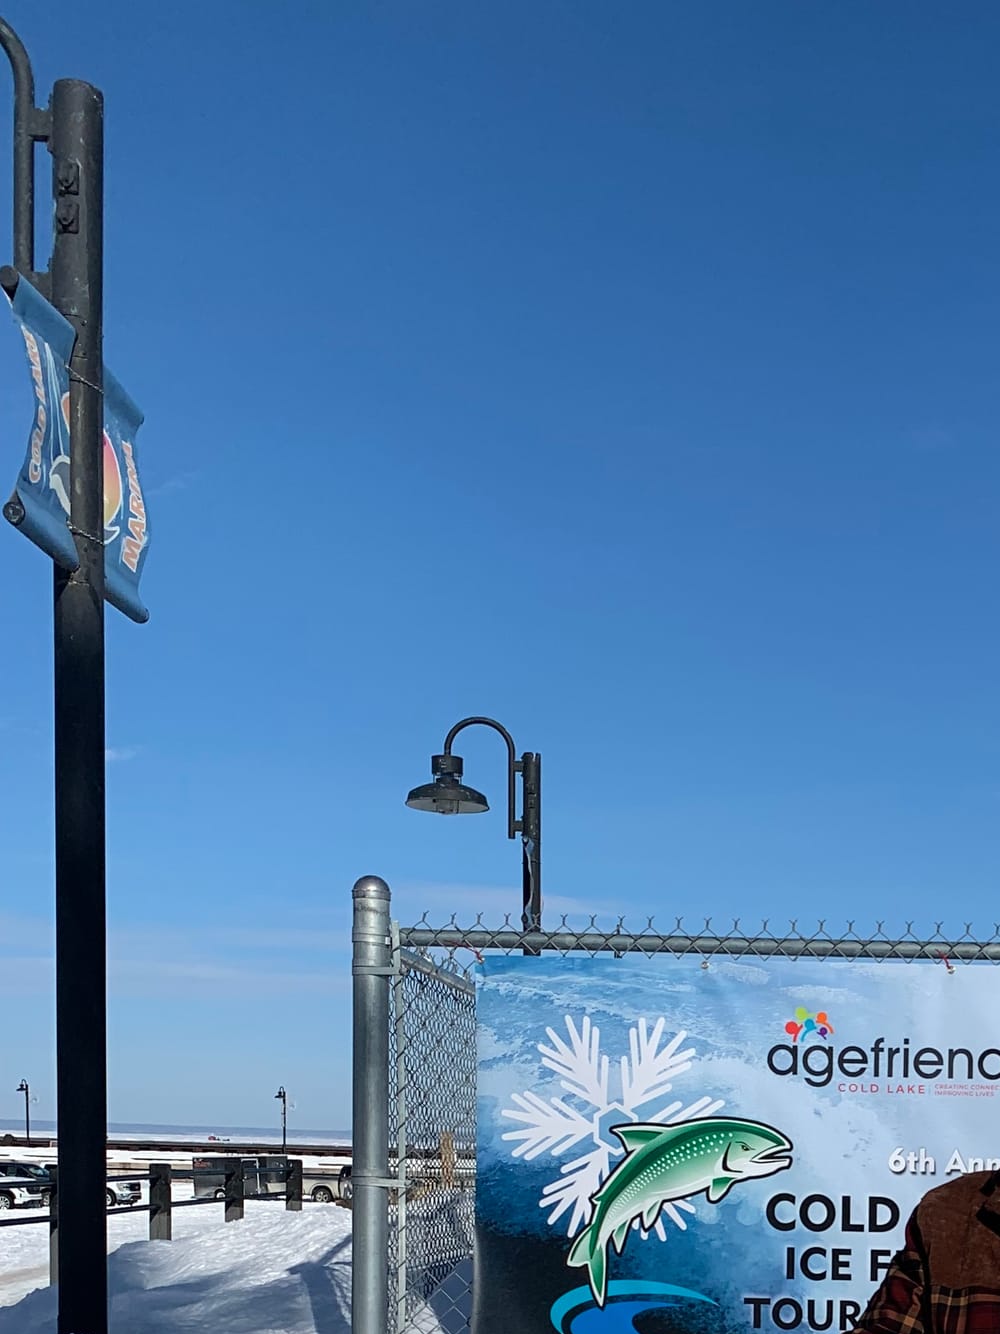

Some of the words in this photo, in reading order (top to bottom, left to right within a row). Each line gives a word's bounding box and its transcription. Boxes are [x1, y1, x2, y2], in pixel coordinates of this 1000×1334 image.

[29, 407, 47, 483] COLD
[838, 1083, 879, 1094] COLD
[887, 1084, 925, 1094] LAKE
[888, 1147, 936, 1175] 6th
[766, 1192, 900, 1233] COLD
[786, 1246, 853, 1281] ICE
